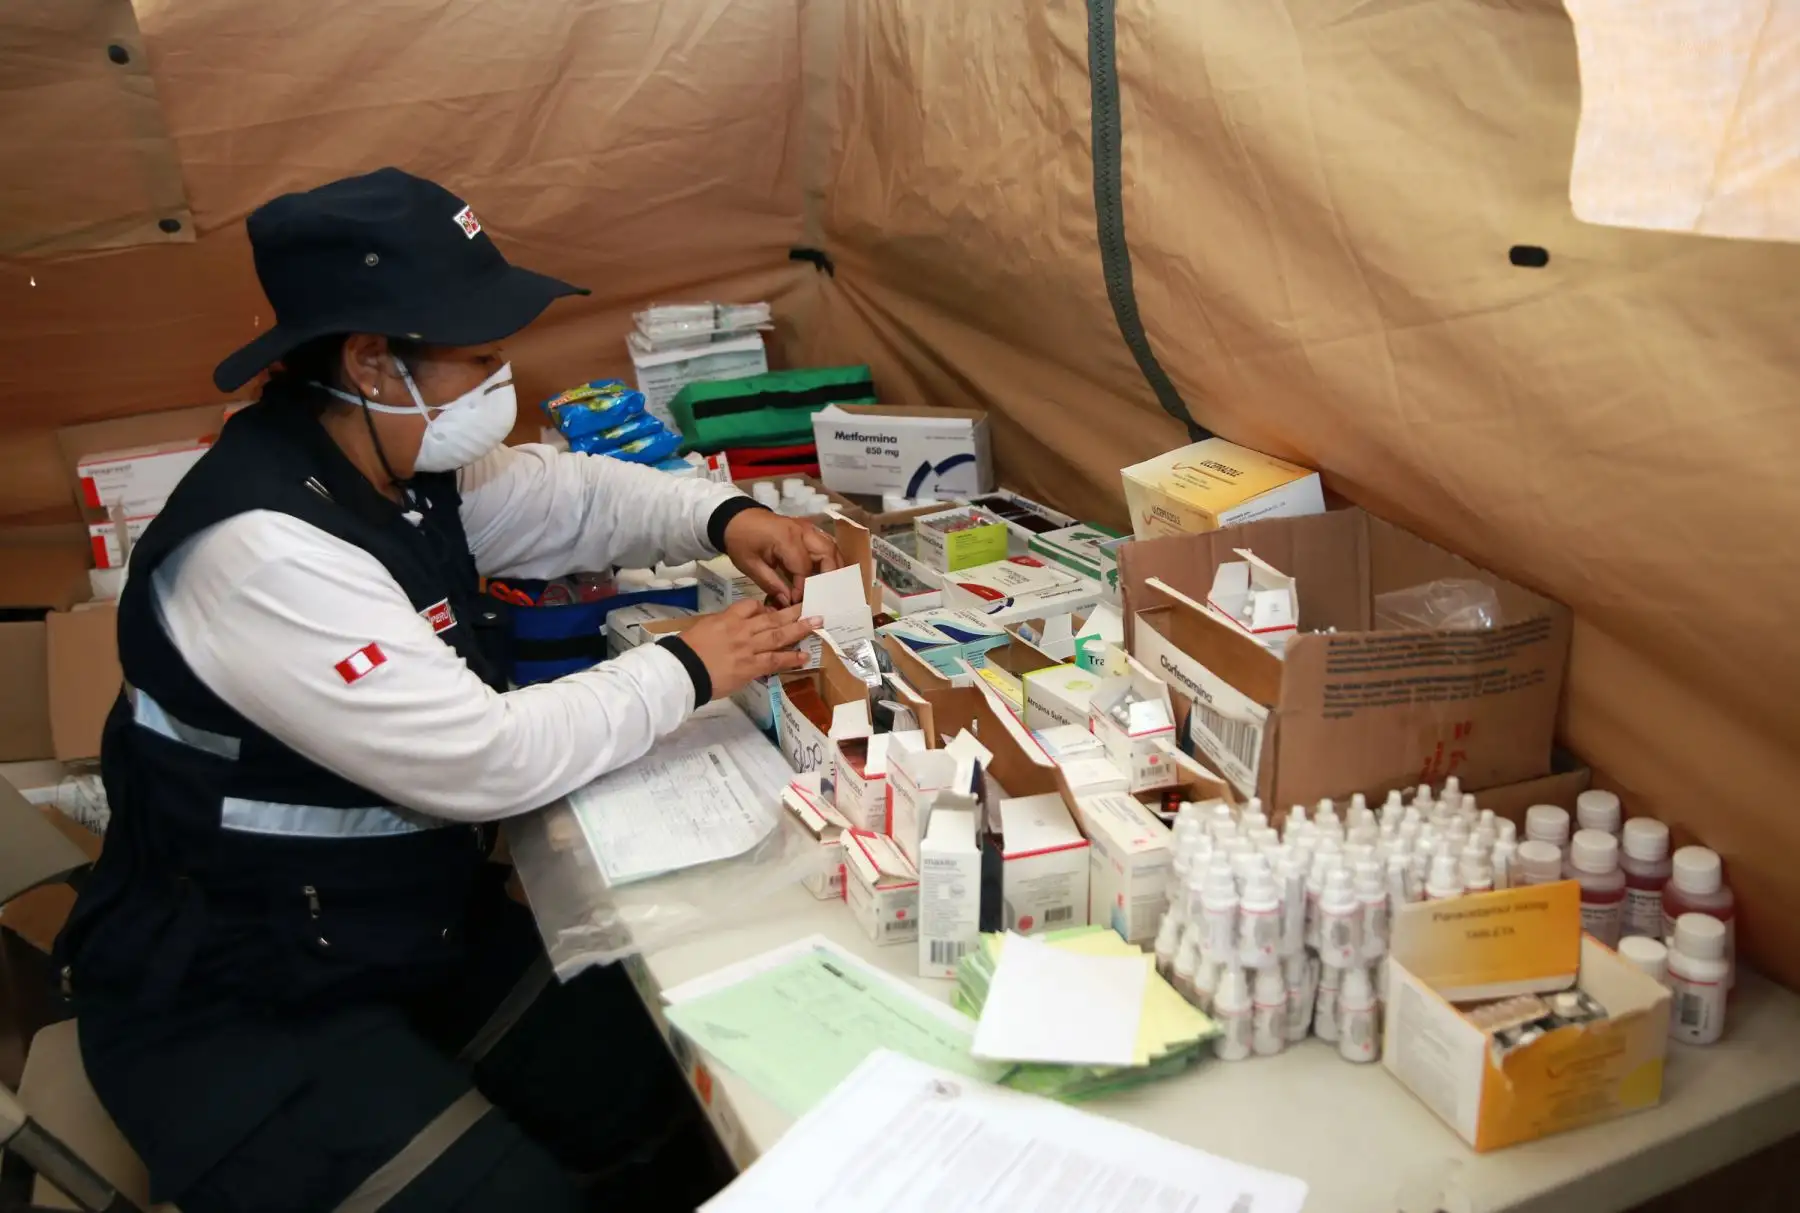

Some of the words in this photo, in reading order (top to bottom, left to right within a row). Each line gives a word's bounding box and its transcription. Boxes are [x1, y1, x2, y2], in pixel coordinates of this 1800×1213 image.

[834, 431, 898, 444] Metformina
[885, 449, 899, 458] mg
[1160, 654, 1214, 704] Clorfenamina
